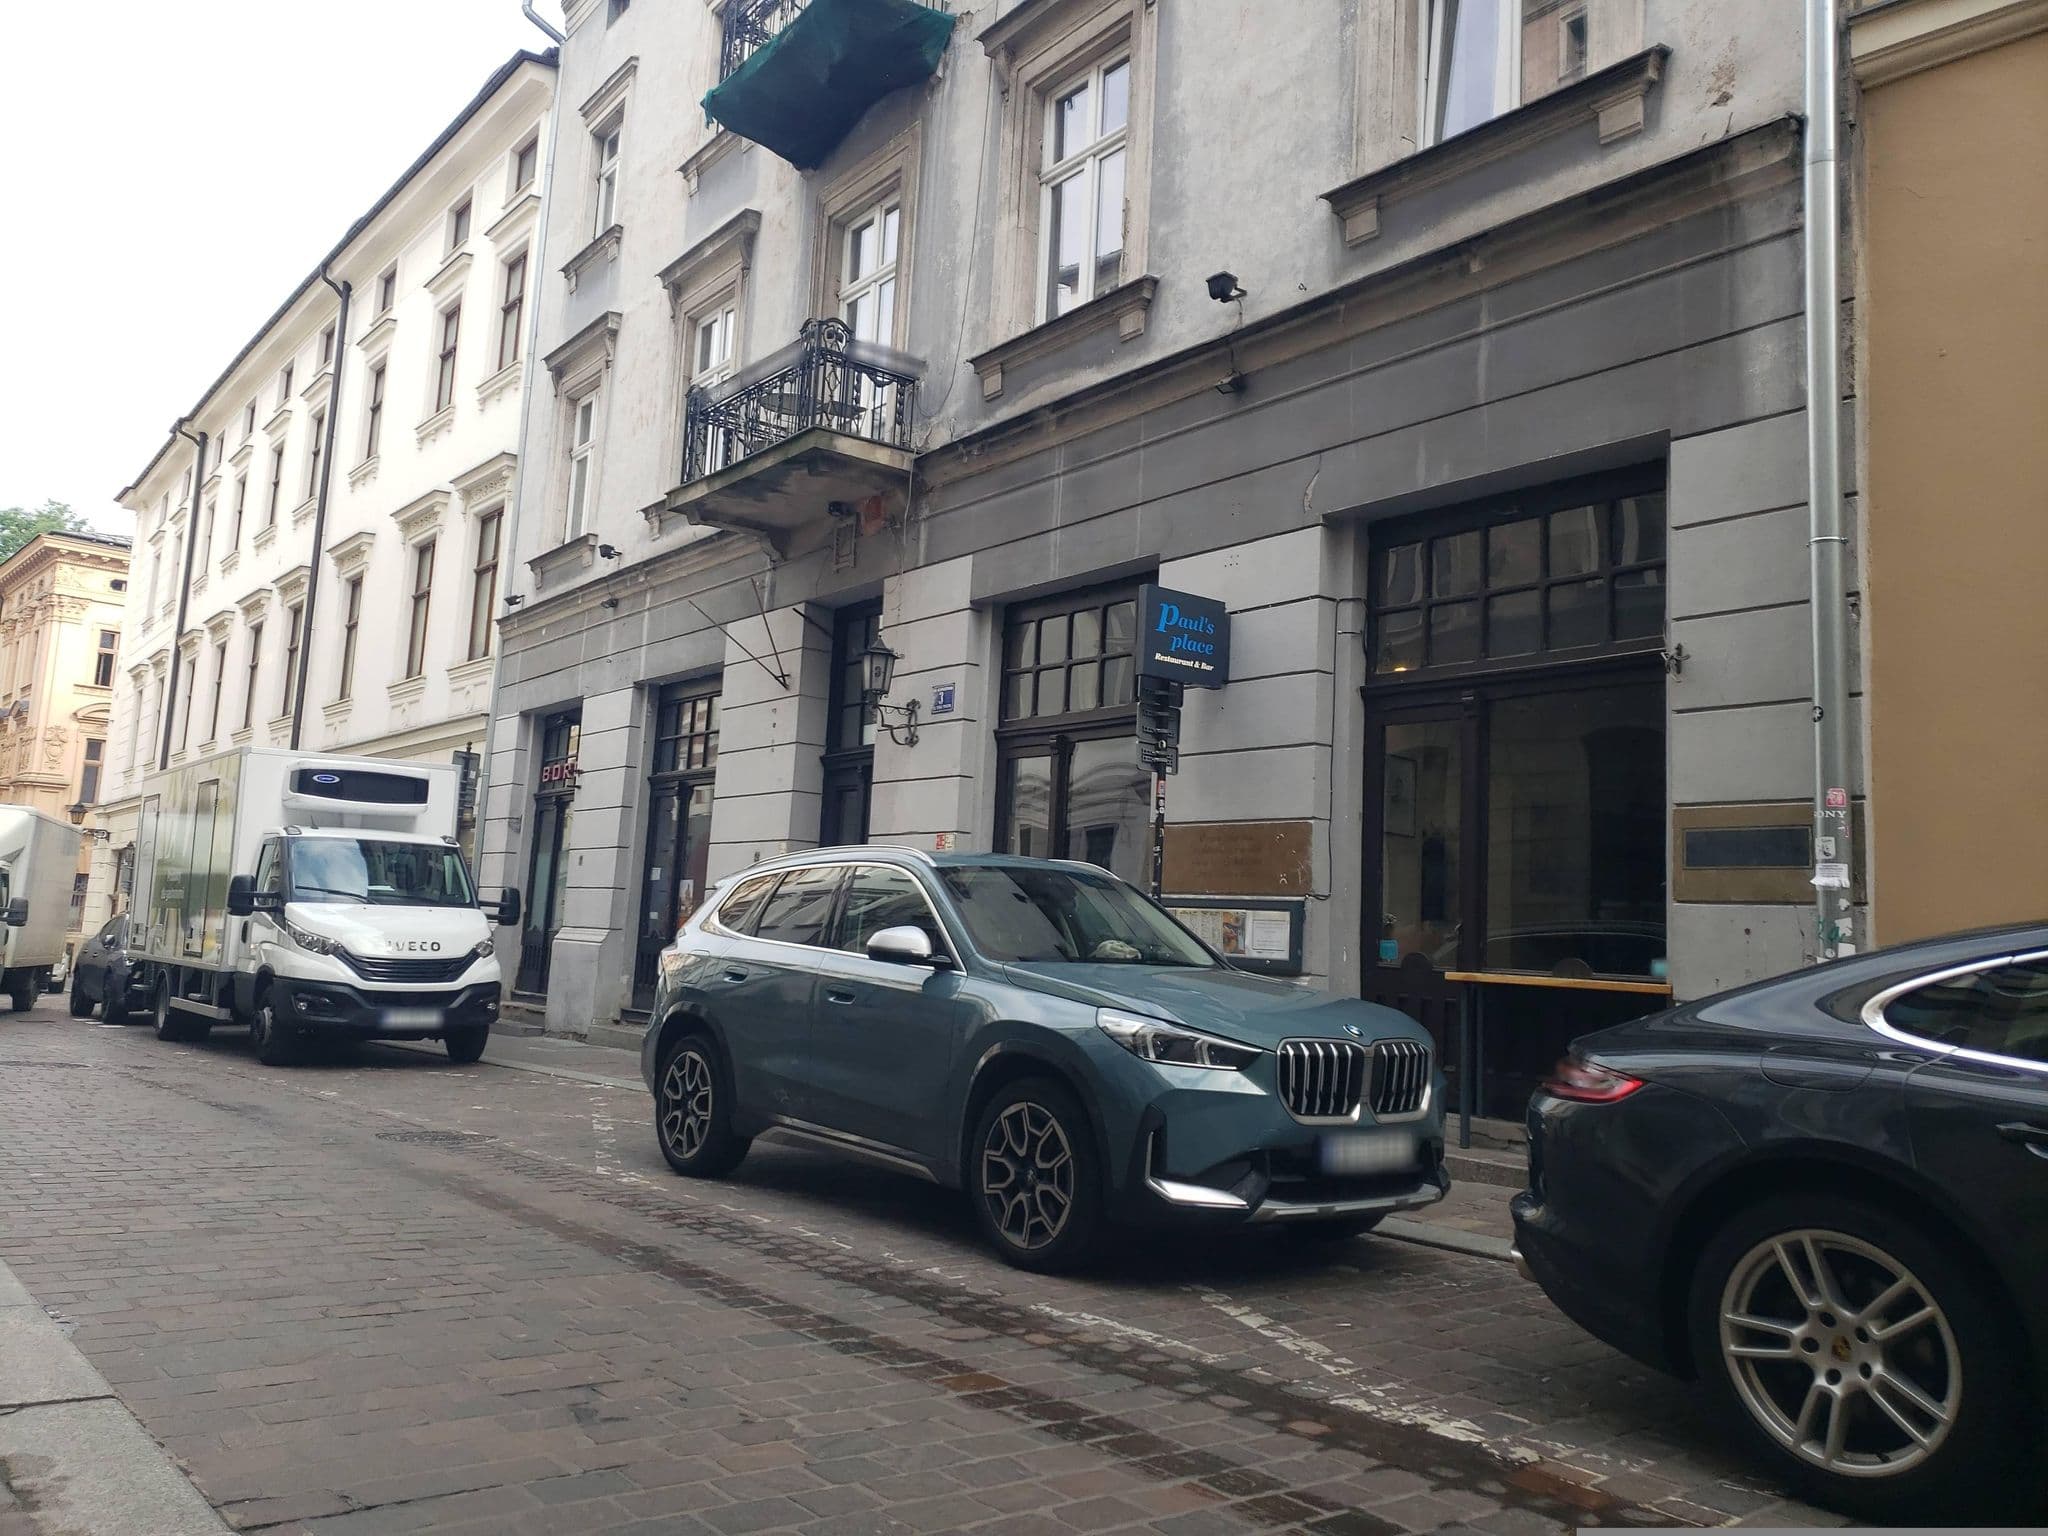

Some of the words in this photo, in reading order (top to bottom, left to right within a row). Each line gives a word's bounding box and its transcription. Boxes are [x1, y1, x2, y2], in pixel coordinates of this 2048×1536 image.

[1154, 602, 1215, 636] Paul's
[1170, 633, 1214, 655] place
[1154, 652, 1194, 667] Restaurant
[1200, 661, 1215, 671] Bar
